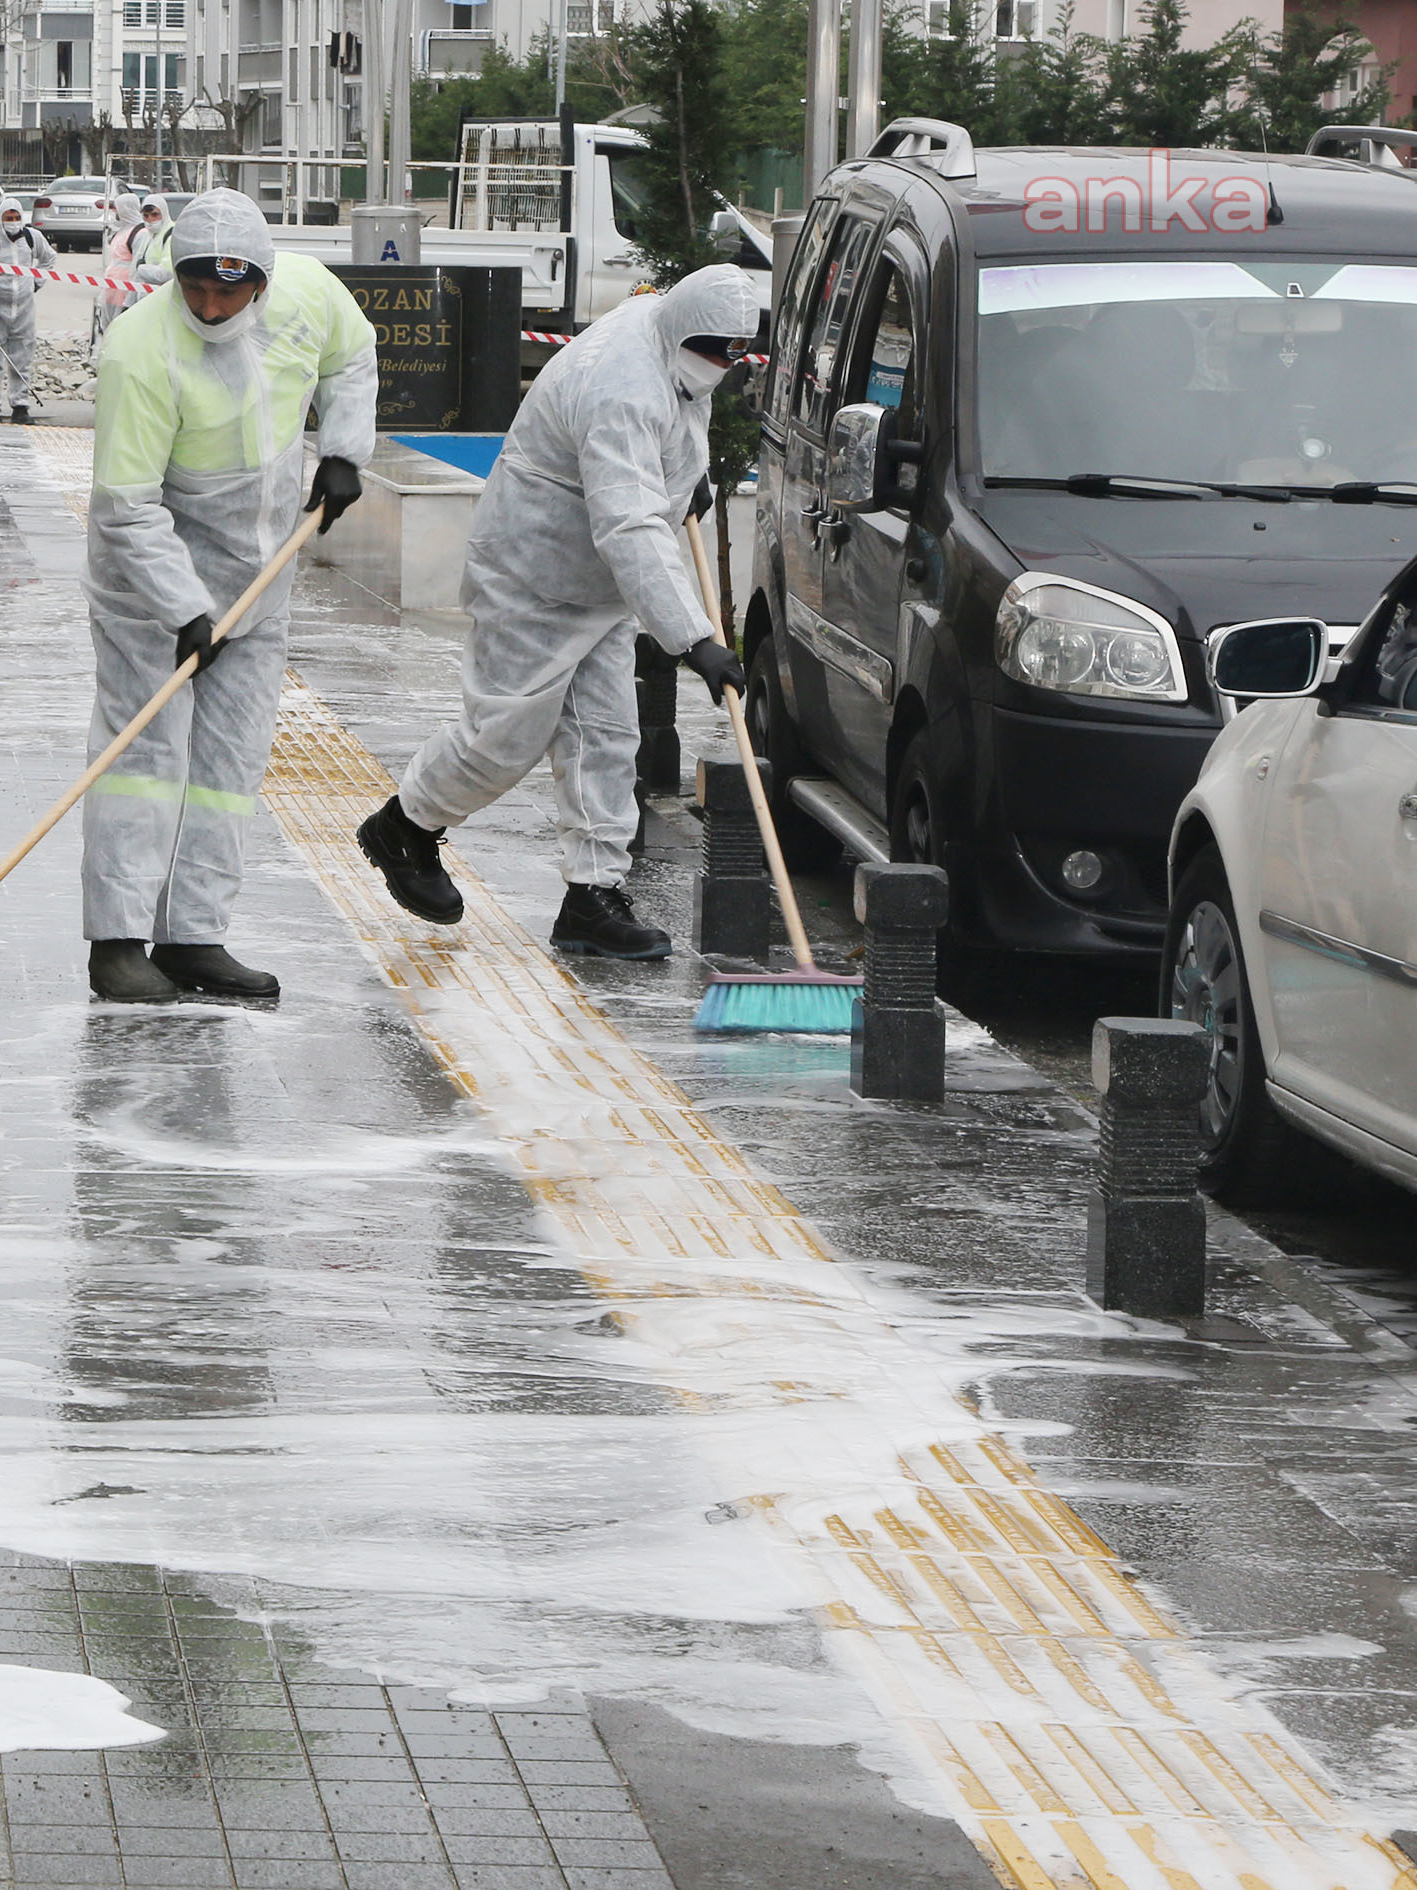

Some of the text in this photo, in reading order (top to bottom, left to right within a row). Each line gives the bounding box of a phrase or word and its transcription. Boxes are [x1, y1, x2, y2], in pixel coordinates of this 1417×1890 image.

[380, 239, 401, 261] A
[352, 288, 434, 311] OZAN
[379, 358, 447, 377] Belediyesi
